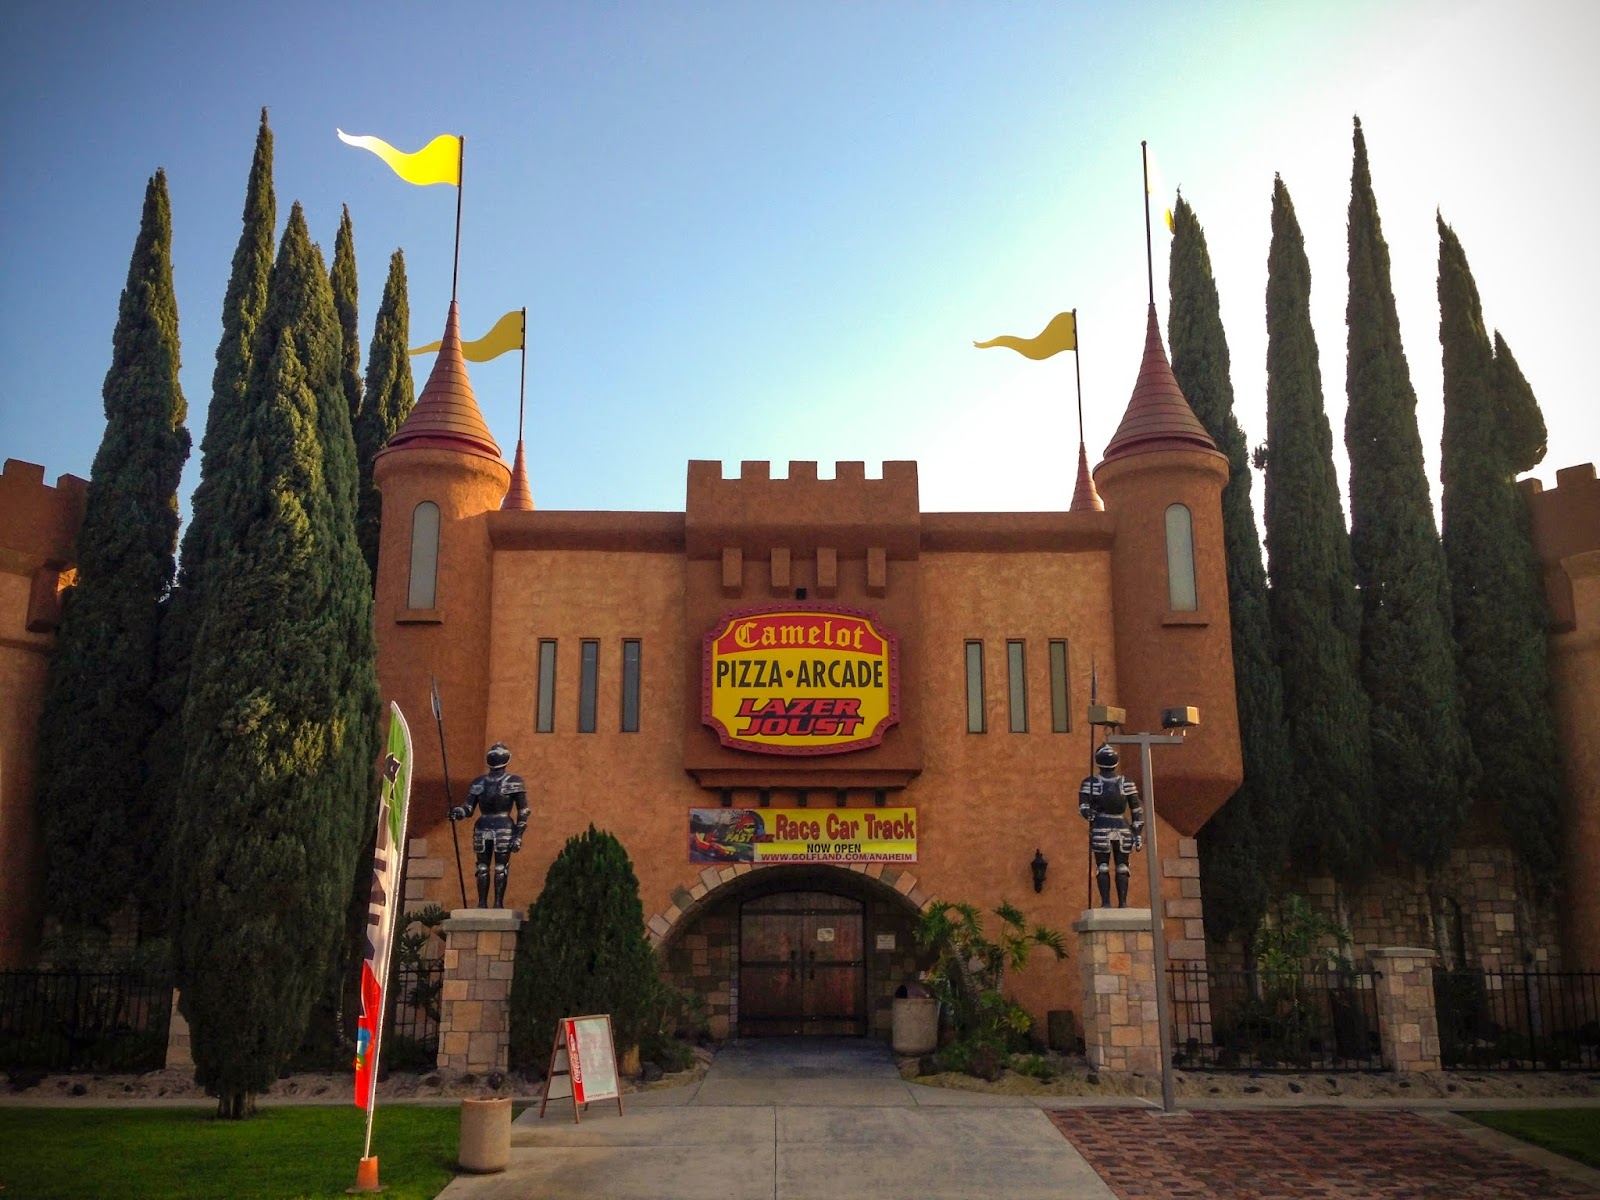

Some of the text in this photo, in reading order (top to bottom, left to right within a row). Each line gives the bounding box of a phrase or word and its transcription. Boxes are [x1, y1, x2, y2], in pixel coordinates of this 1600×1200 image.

[735, 620, 865, 649] Camelot
[716, 660, 883, 688] PIZZA ARCADE
[735, 698, 862, 717] LAZER
[736, 717, 865, 736] JOUST
[775, 812, 915, 840] Race Car Track
[724, 832, 754, 843] FAST
[761, 853, 912, 861] WWW.GOLFLAND.COM/ANAHEIM
[807, 843, 861, 853] NOW OPEN
